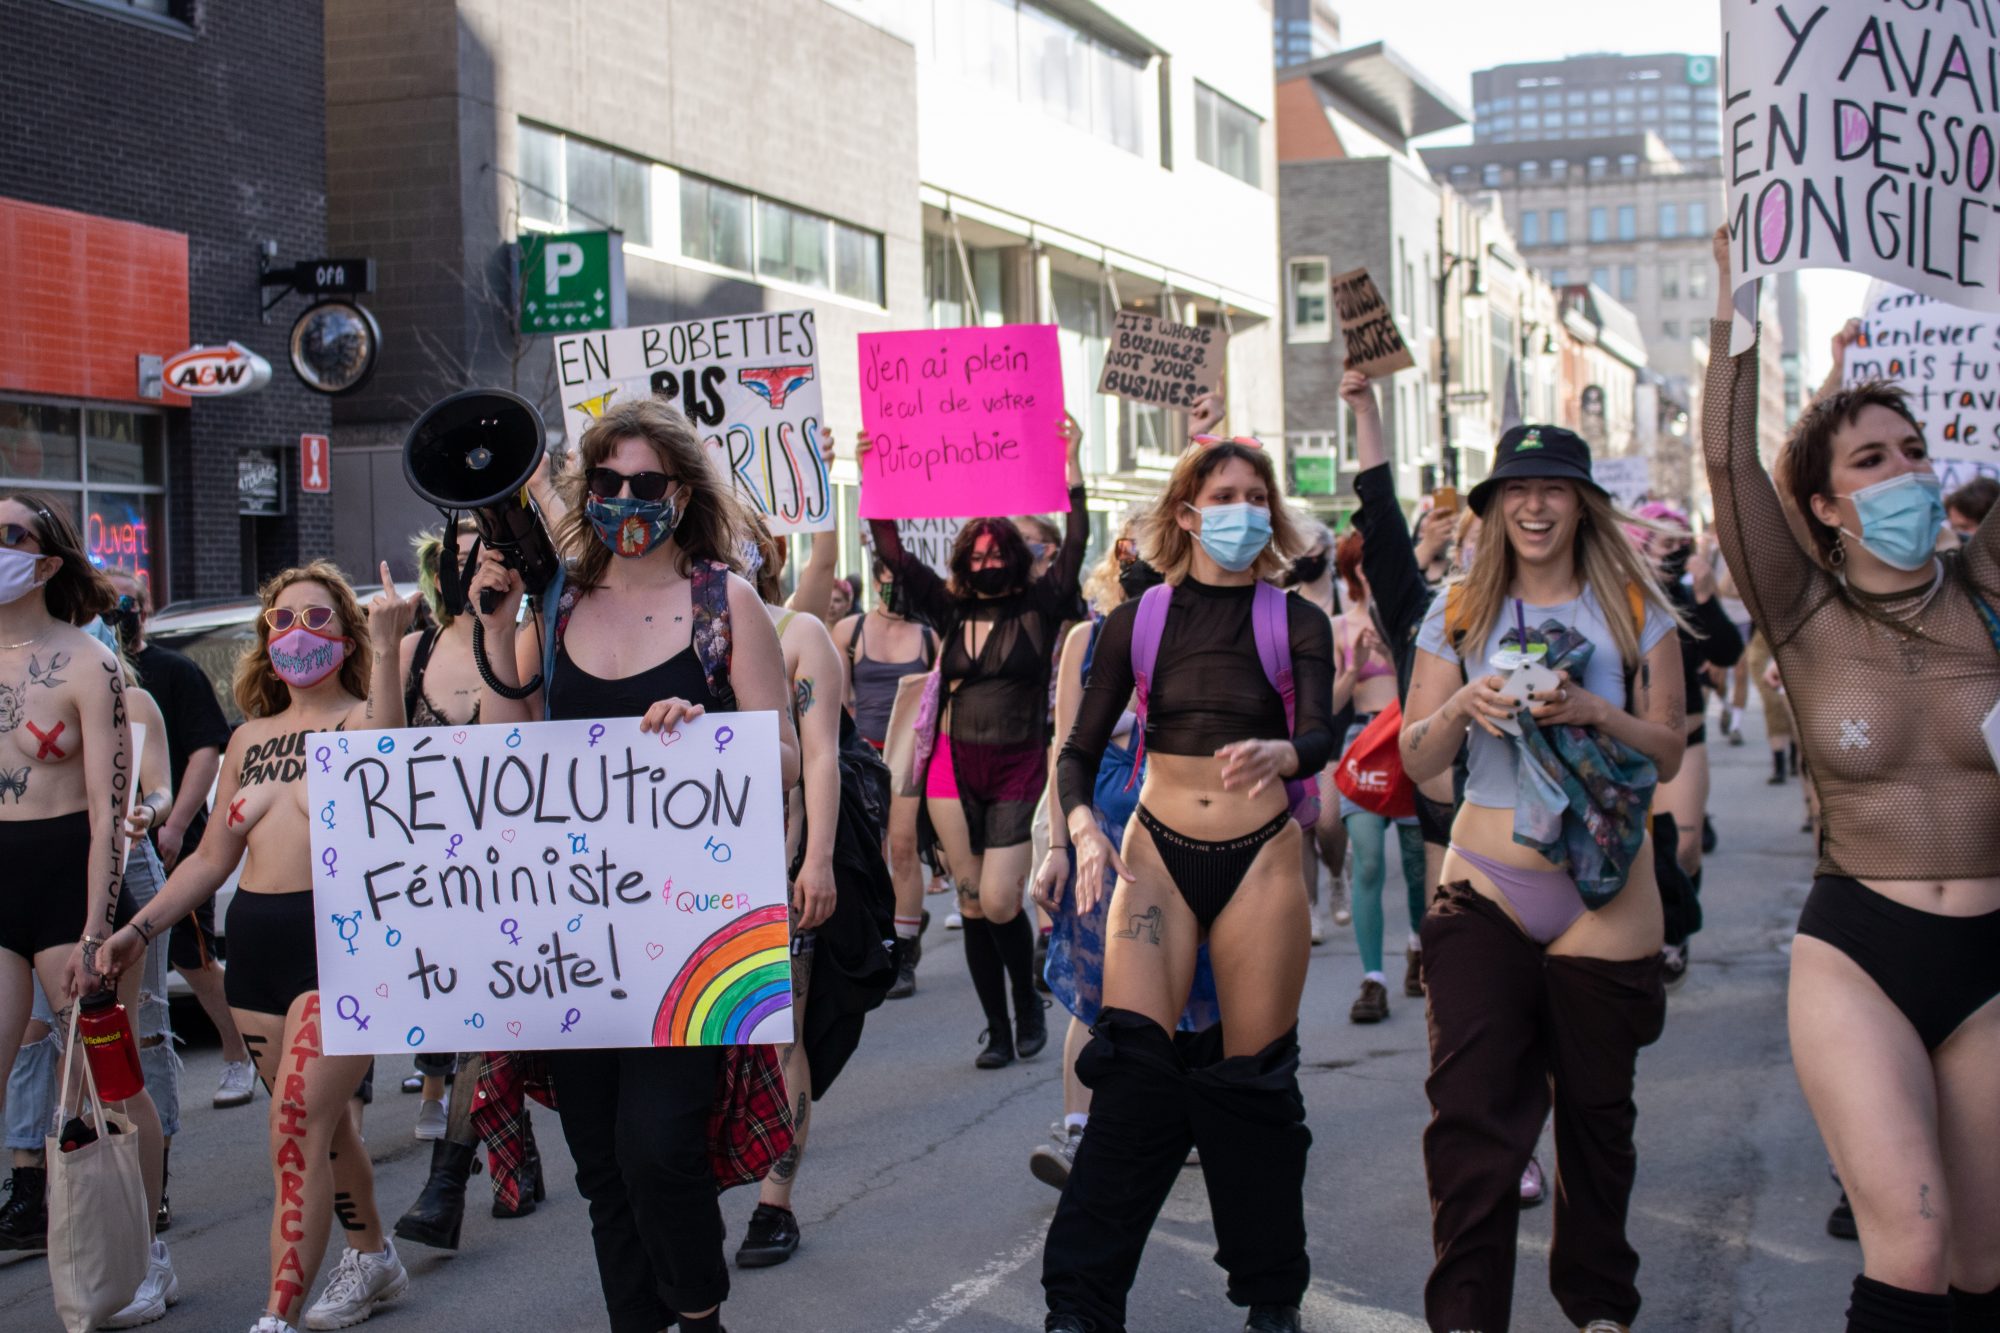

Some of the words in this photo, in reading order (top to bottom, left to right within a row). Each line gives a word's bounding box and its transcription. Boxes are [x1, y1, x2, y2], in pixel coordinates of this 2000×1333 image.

[1774, 4, 1830, 86] Y
[1837, 15, 2000, 114] AVAI
[1733, 92, 1808, 187] EN
[1833, 98, 2000, 194] DESSO
[1866, 173, 2000, 294] GILE
[544, 241, 585, 296] P
[559, 334, 611, 386] EN
[642, 311, 815, 368] BOBETTES
[1158, 321, 1212, 345] WHORE
[176, 364, 248, 387] A&W
[921, 347, 948, 379] ai
[964, 343, 1029, 384] plein
[1106, 350, 1144, 371] NOT
[1150, 358, 1197, 381] YOUR
[1853, 350, 1937, 381] mais
[1951, 351, 1989, 382] tu
[939, 388, 971, 413] de
[1921, 384, 2000, 412] trav
[1944, 413, 1981, 446] de
[88, 512, 149, 555] Ouvert
[363, 846, 652, 921] Féministe
[407, 947, 458, 999] tu
[488, 922, 629, 1000] suite!
[275, 993, 321, 1318] PATRIARCAT
